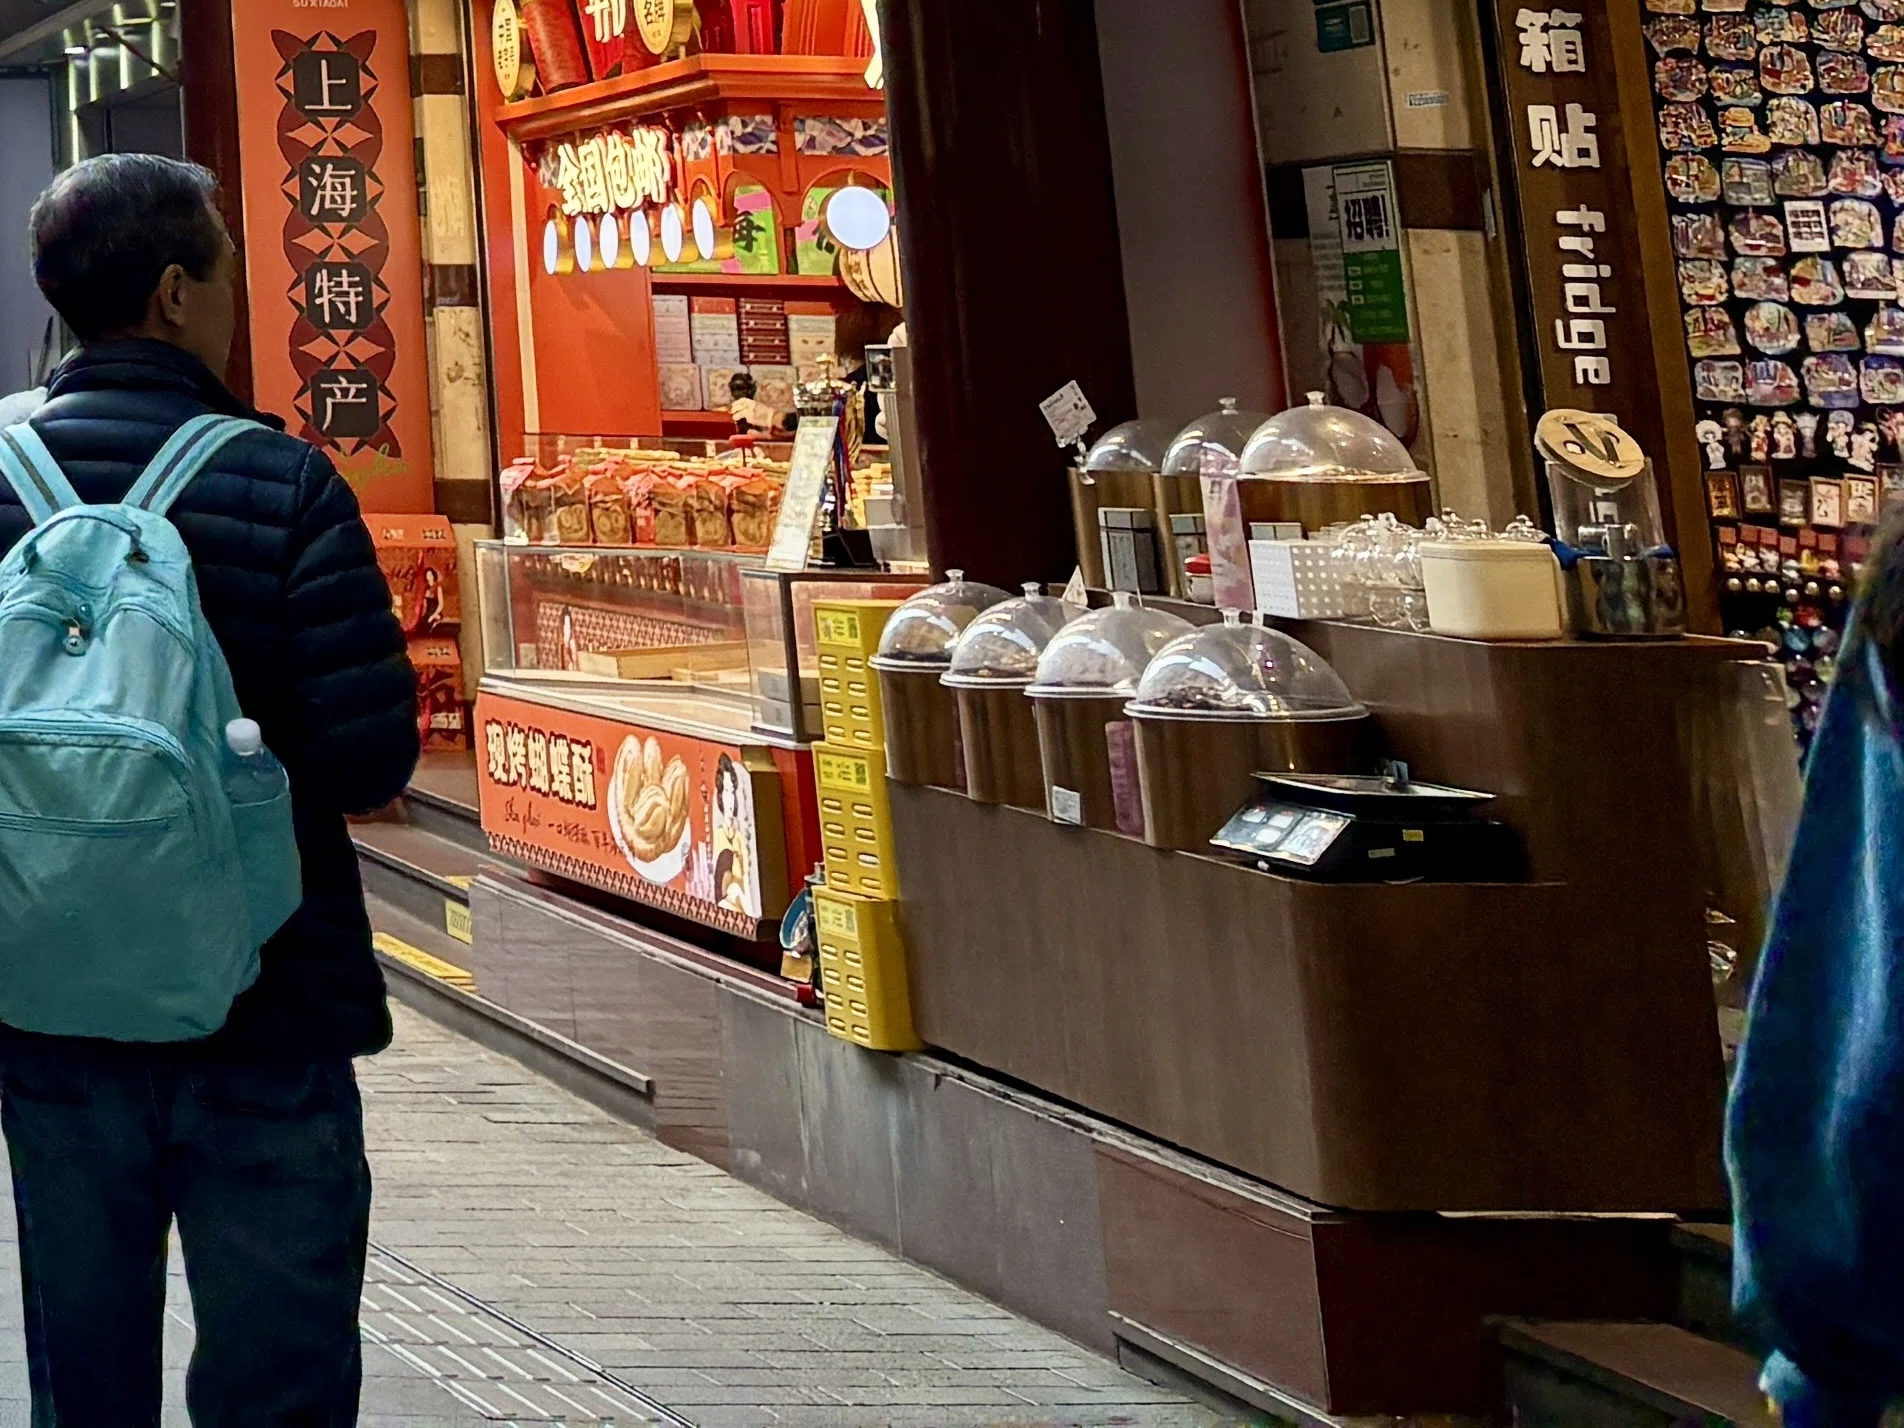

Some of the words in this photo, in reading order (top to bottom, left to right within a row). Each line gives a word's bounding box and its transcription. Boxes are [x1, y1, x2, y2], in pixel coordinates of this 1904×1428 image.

[556, 127, 674, 216] 全国包邮
[299, 56, 370, 436] 上海特产
[1555, 204, 1616, 386] fridge
[485, 718, 597, 811] 现烤蝴蝶酥
